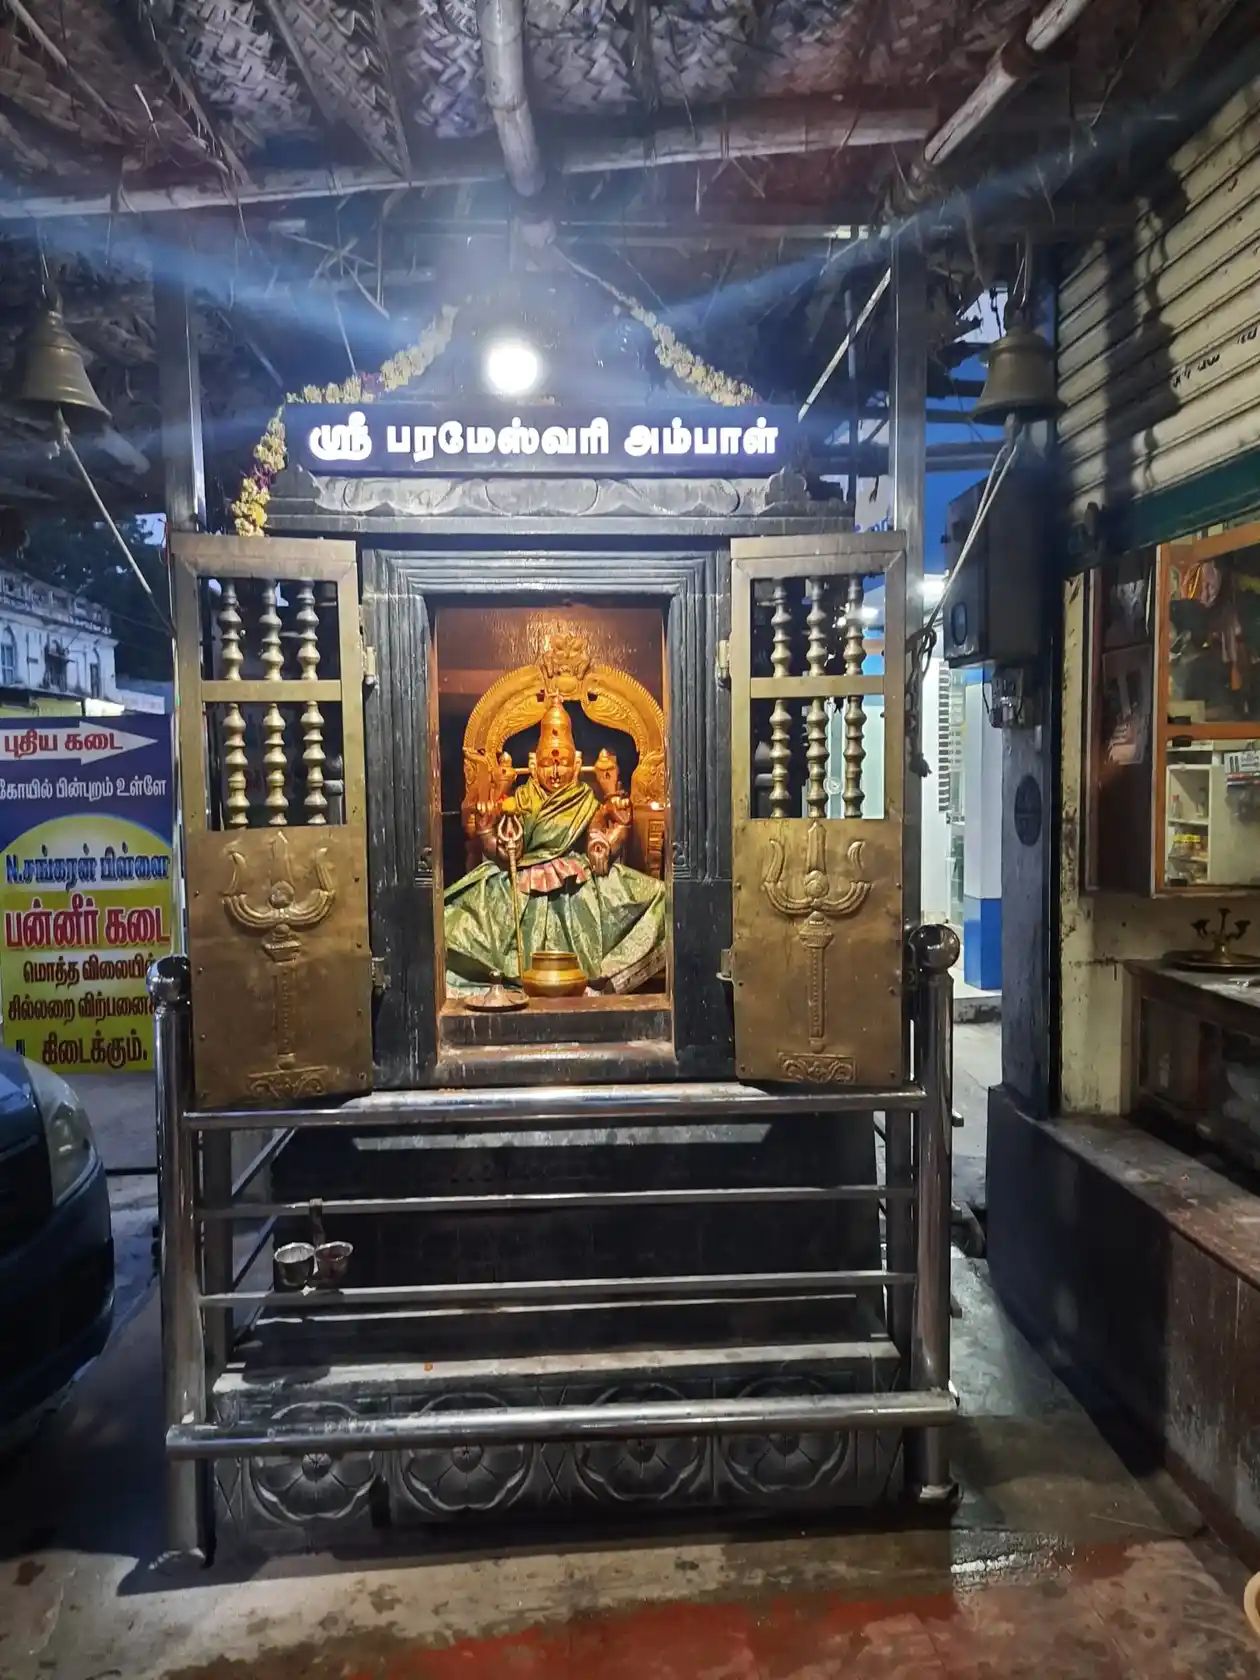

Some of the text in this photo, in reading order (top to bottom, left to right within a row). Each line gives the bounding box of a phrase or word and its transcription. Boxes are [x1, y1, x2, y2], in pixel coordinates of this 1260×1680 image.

[386, 416, 609, 463] பரமேஸ்வரி
[624, 416, 779, 457] அம்பாள்
[4, 728, 123, 759] புதிய கடை
[56, 776, 114, 802] பின்புறம்
[116, 774, 167, 797] உள்ளே
[100, 842, 171, 884] பிள்ளை
[5, 892, 172, 949] பன்னீர் கடை
[23, 952, 156, 989] மொத்த விலையி
[8, 993, 76, 1026] சில்லறை
[42, 1028, 148, 1069] கிடைக்கும்.
